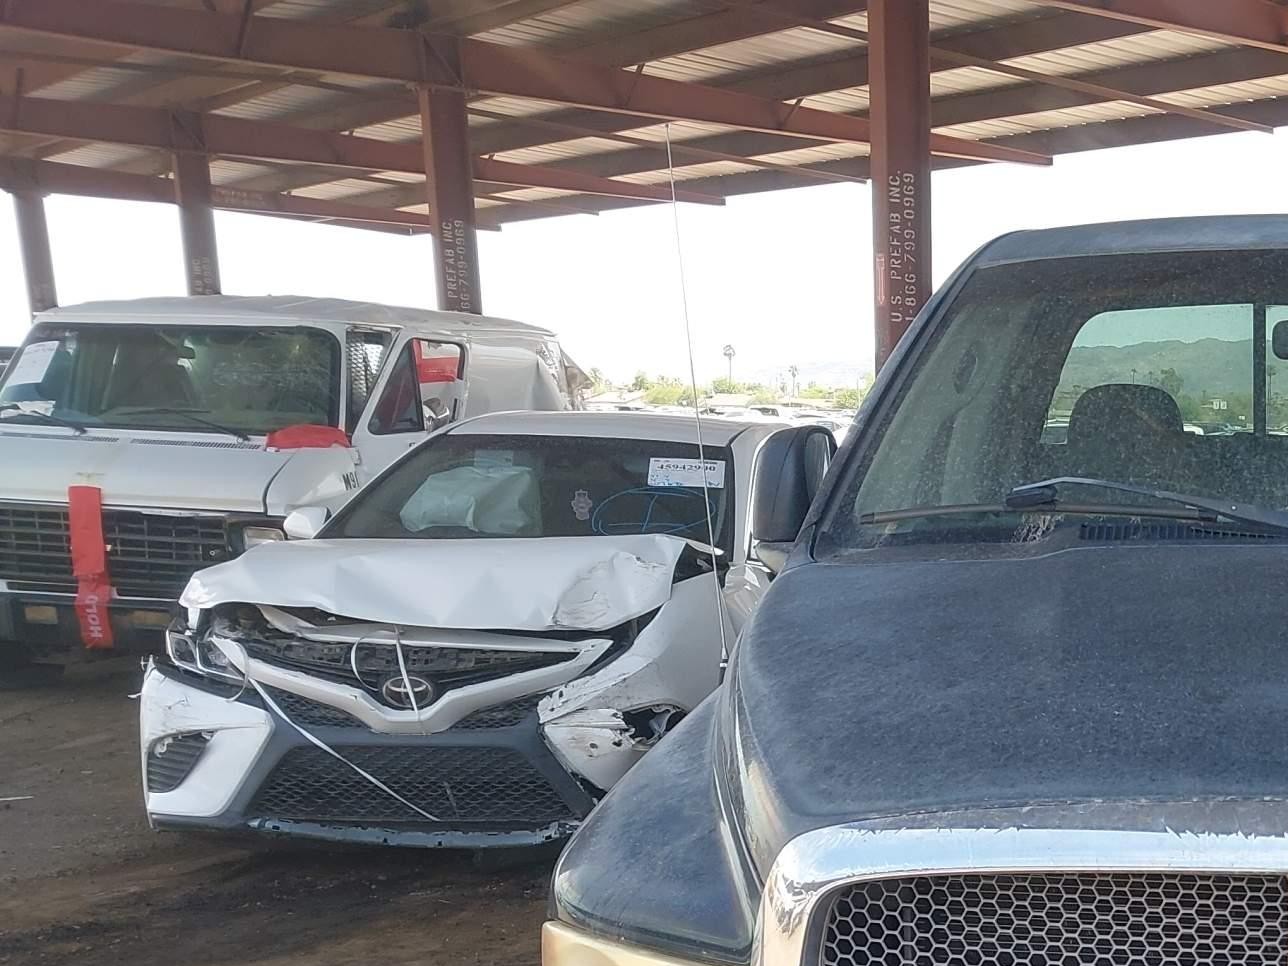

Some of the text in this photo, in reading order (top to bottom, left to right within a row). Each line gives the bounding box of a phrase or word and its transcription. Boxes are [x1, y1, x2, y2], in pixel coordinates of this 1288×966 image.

[444, 249, 458, 298] PREFAB
[454, 220, 471, 312] 66-799-0969
[888, 170, 902, 322] U.S. PREFAB INC.
[85, 595, 103, 638] HOLD
